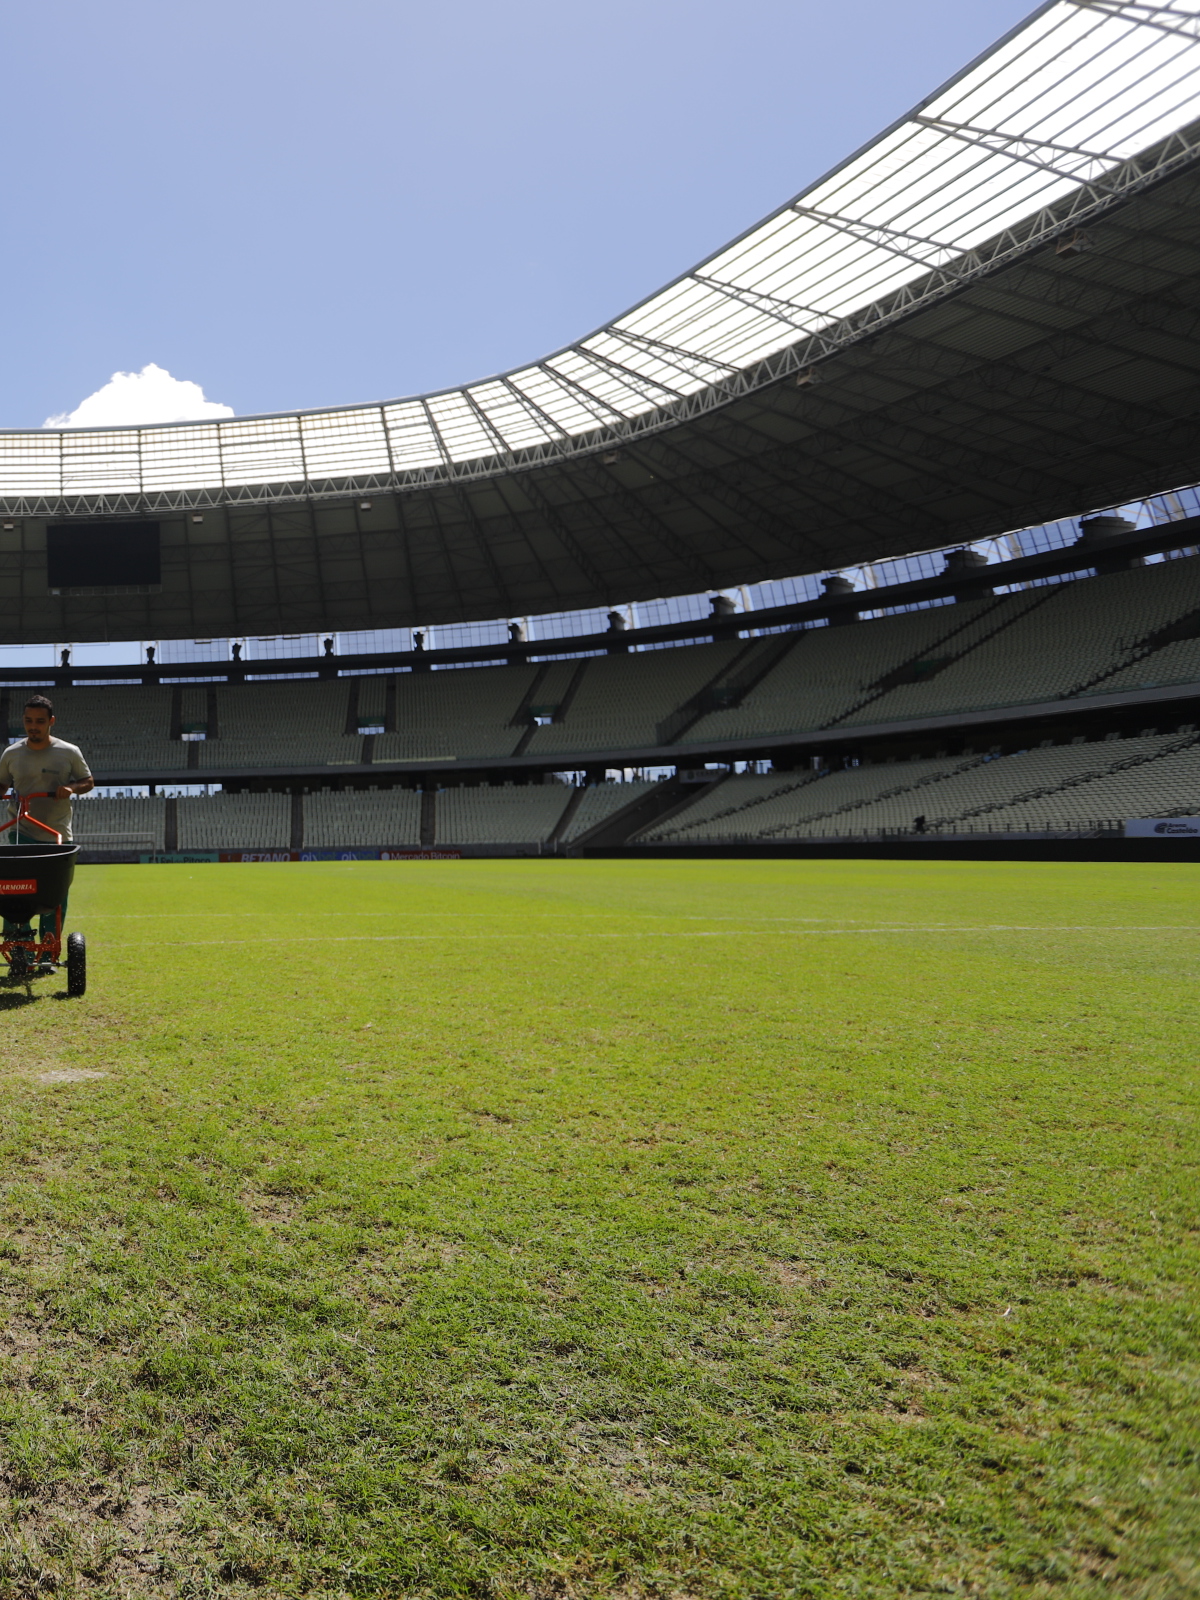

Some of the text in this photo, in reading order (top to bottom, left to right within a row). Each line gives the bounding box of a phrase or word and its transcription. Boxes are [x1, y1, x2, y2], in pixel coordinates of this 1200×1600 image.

[241, 853, 291, 862] BETANO
[391, 851, 460, 860] Mercado Bitcoin
